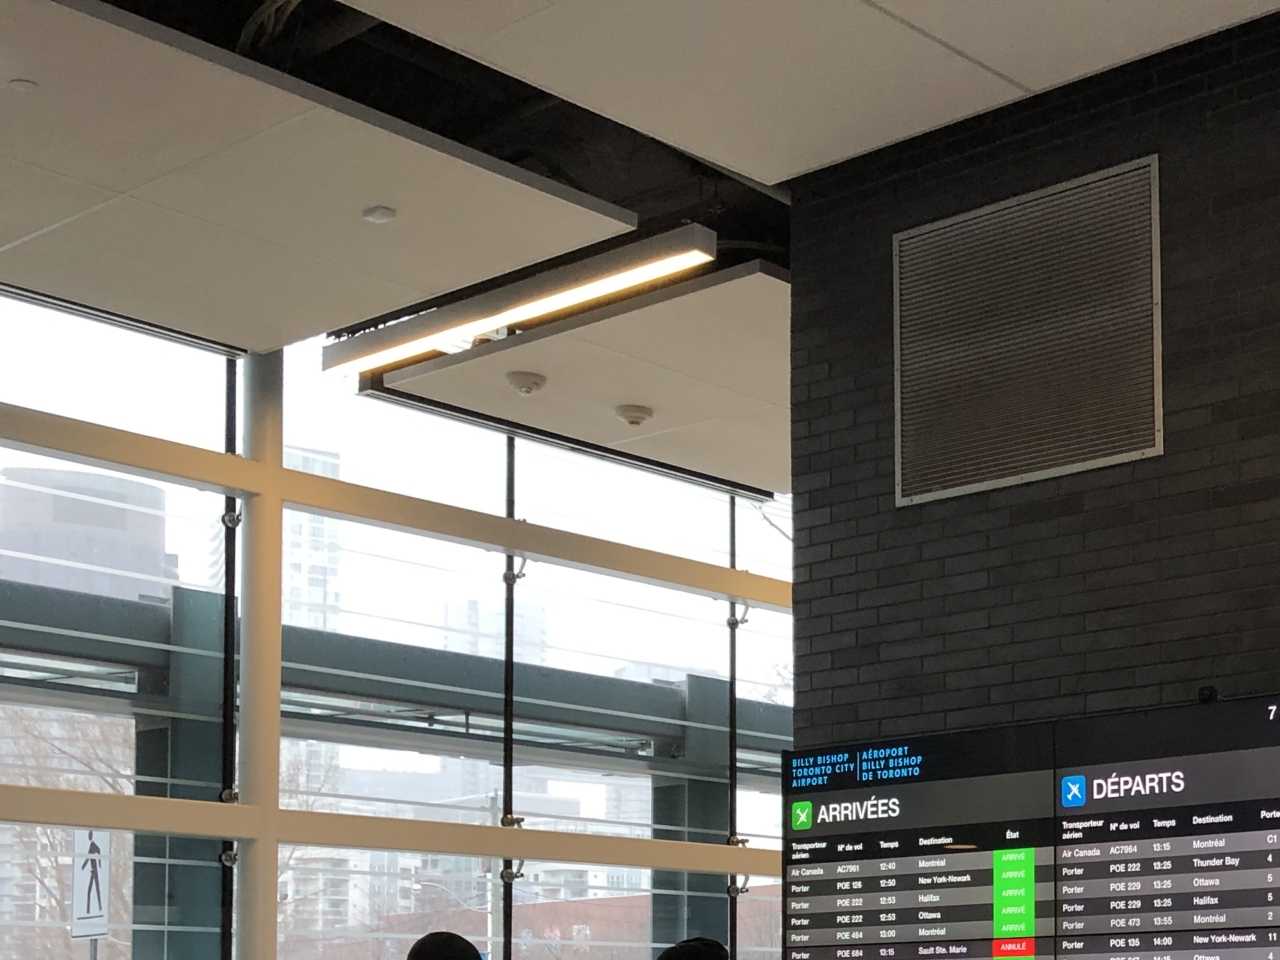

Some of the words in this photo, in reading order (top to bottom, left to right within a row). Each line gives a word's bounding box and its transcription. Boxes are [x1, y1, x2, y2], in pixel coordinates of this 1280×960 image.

[1268, 706, 1277, 720] 7
[793, 757, 816, 767] BILLY
[818, 754, 848, 764] BISHOP
[862, 747, 909, 762] AÉROPORT
[792, 766, 831, 779] TORONTO
[836, 763, 854, 773] CITY
[863, 760, 885, 770] BILLY
[889, 756, 922, 767] BISHOP
[792, 776, 827, 787] AIRPORT
[863, 772, 873, 780] DE
[877, 767, 919, 779] TORONTO
[1093, 771, 1184, 799] DÉPARTS
[817, 796, 899, 823] ARRIVÉES
[1062, 820, 1104, 829] Transporteur
[1119, 822, 1128, 830] de
[1129, 821, 1139, 829] vol
[1153, 819, 1176, 828] Temps
[1193, 814, 1233, 824] Destination
[1261, 810, 1280, 818] Porte
[792, 842, 827, 850] Transporteur
[879, 841, 899, 849] Temps
[919, 837, 954, 847] Destination
[1006, 830, 1019, 839] État
[1062, 831, 1082, 839] aérien
[1074, 848, 1100, 857] Canada
[1153, 842, 1170, 851] 13:15
[1193, 838, 1225, 848] Montréal
[1267, 835, 1276, 843] C1
[880, 862, 895, 870] 12:40
[919, 859, 945, 867] Montréal
[1002, 852, 1025, 861] ARRIVÉ
[1110, 864, 1125, 872] POE
[1128, 863, 1140, 871] 222
[1153, 861, 1172, 869] 13:25
[1193, 858, 1223, 867] Thunder
[1225, 857, 1239, 866] Bay
[1267, 854, 1272, 862] 4
[1063, 886, 1084, 894] Porter
[1110, 883, 1125, 891] POE
[1128, 882, 1141, 890] 229
[1153, 880, 1171, 888] 13:25
[1193, 878, 1219, 886] Ottawa
[1268, 874, 1272, 882] 5
[852, 898, 862, 906] 222
[919, 894, 939, 902] Halifax
[1002, 888, 1025, 896] ARRIVÉ
[1063, 941, 1084, 949] Porter
[1110, 939, 1125, 947] POE
[1128, 938, 1140, 946] 135
[1153, 937, 1172, 945] 14:00
[1210, 933, 1256, 943] York-Newark
[1268, 933, 1276, 941] 11
[1268, 952, 1273, 960] 4
